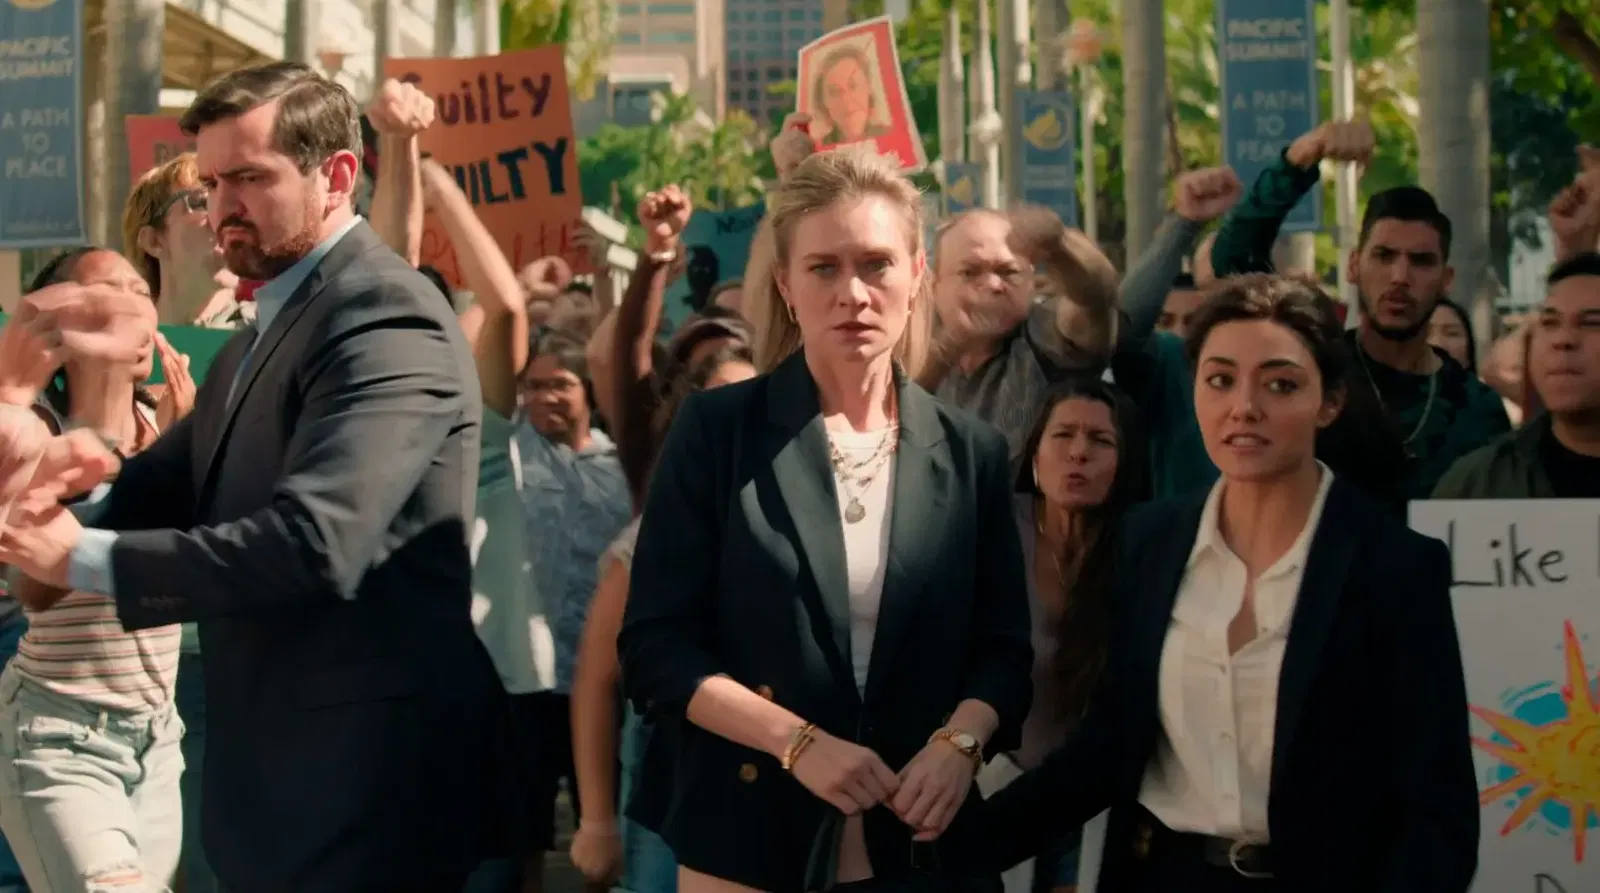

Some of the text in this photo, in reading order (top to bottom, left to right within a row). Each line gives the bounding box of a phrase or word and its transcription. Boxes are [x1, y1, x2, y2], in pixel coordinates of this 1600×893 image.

[1227, 19, 1304, 38] PACIFIC
[1226, 41, 1308, 61] SUMMIT
[402, 72, 551, 125] uilty
[1232, 91, 1305, 110] A PATH
[2, 108, 69, 129] A PATH
[1256, 115, 1285, 137] TO
[22, 131, 50, 154] TO
[5, 156, 67, 179] PEACE
[420, 137, 568, 207] UILTY
[1448, 518, 1568, 588] Like
